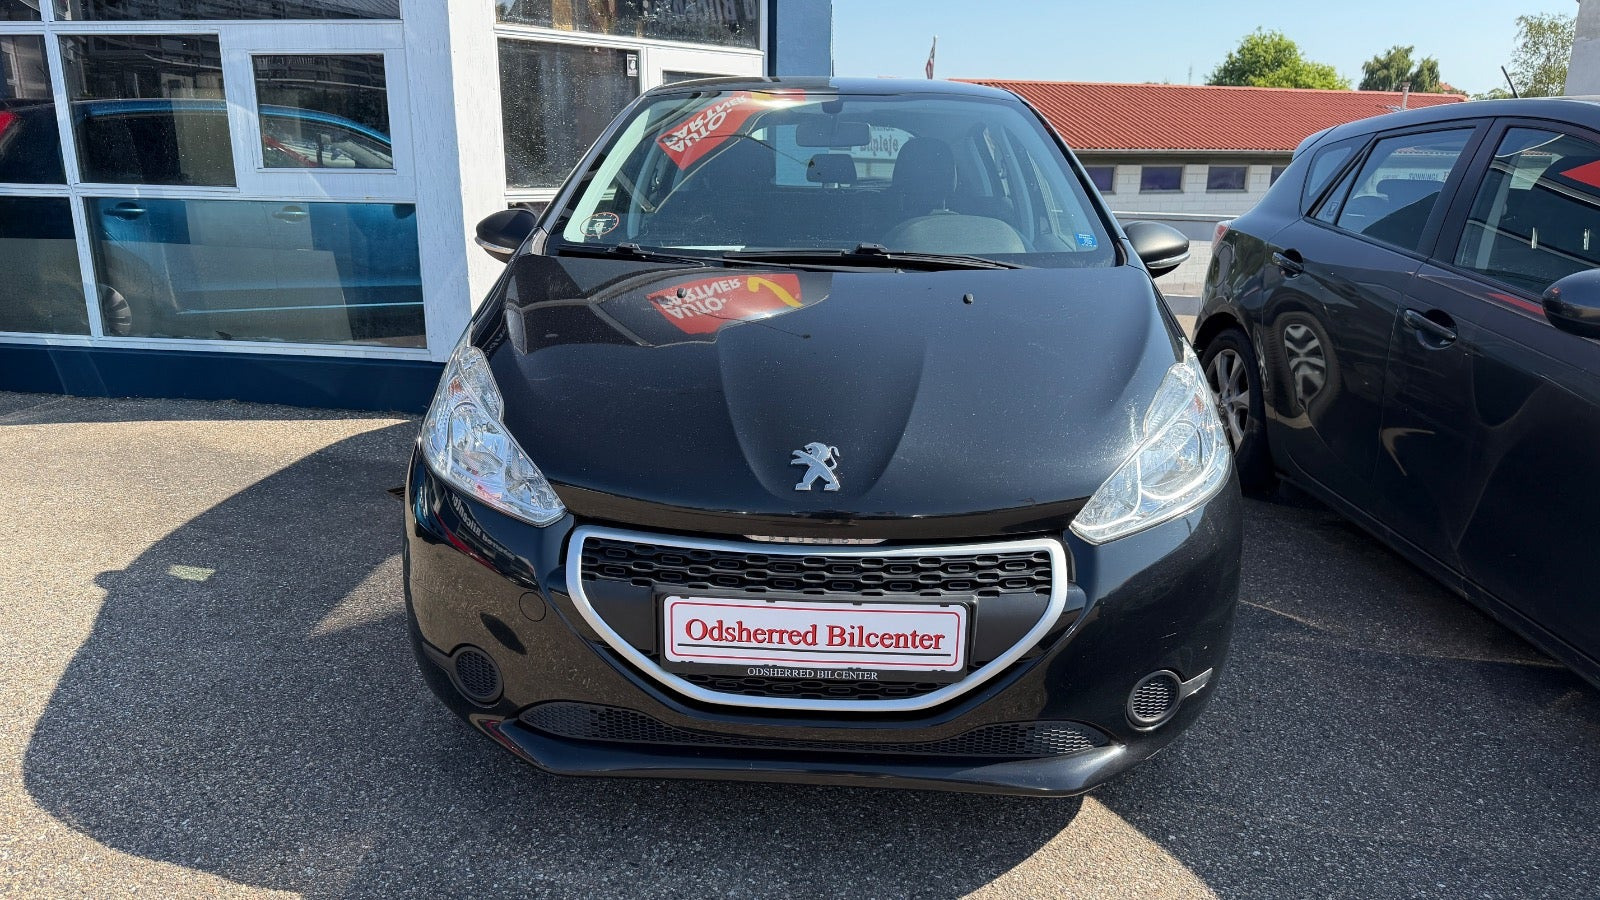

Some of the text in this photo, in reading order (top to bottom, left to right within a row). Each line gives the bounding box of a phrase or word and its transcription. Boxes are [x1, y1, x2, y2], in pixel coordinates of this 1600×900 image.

[685, 618, 946, 650] Odsherred Bilcenter
[747, 667, 878, 680] ODSHERRED BILCENTER
